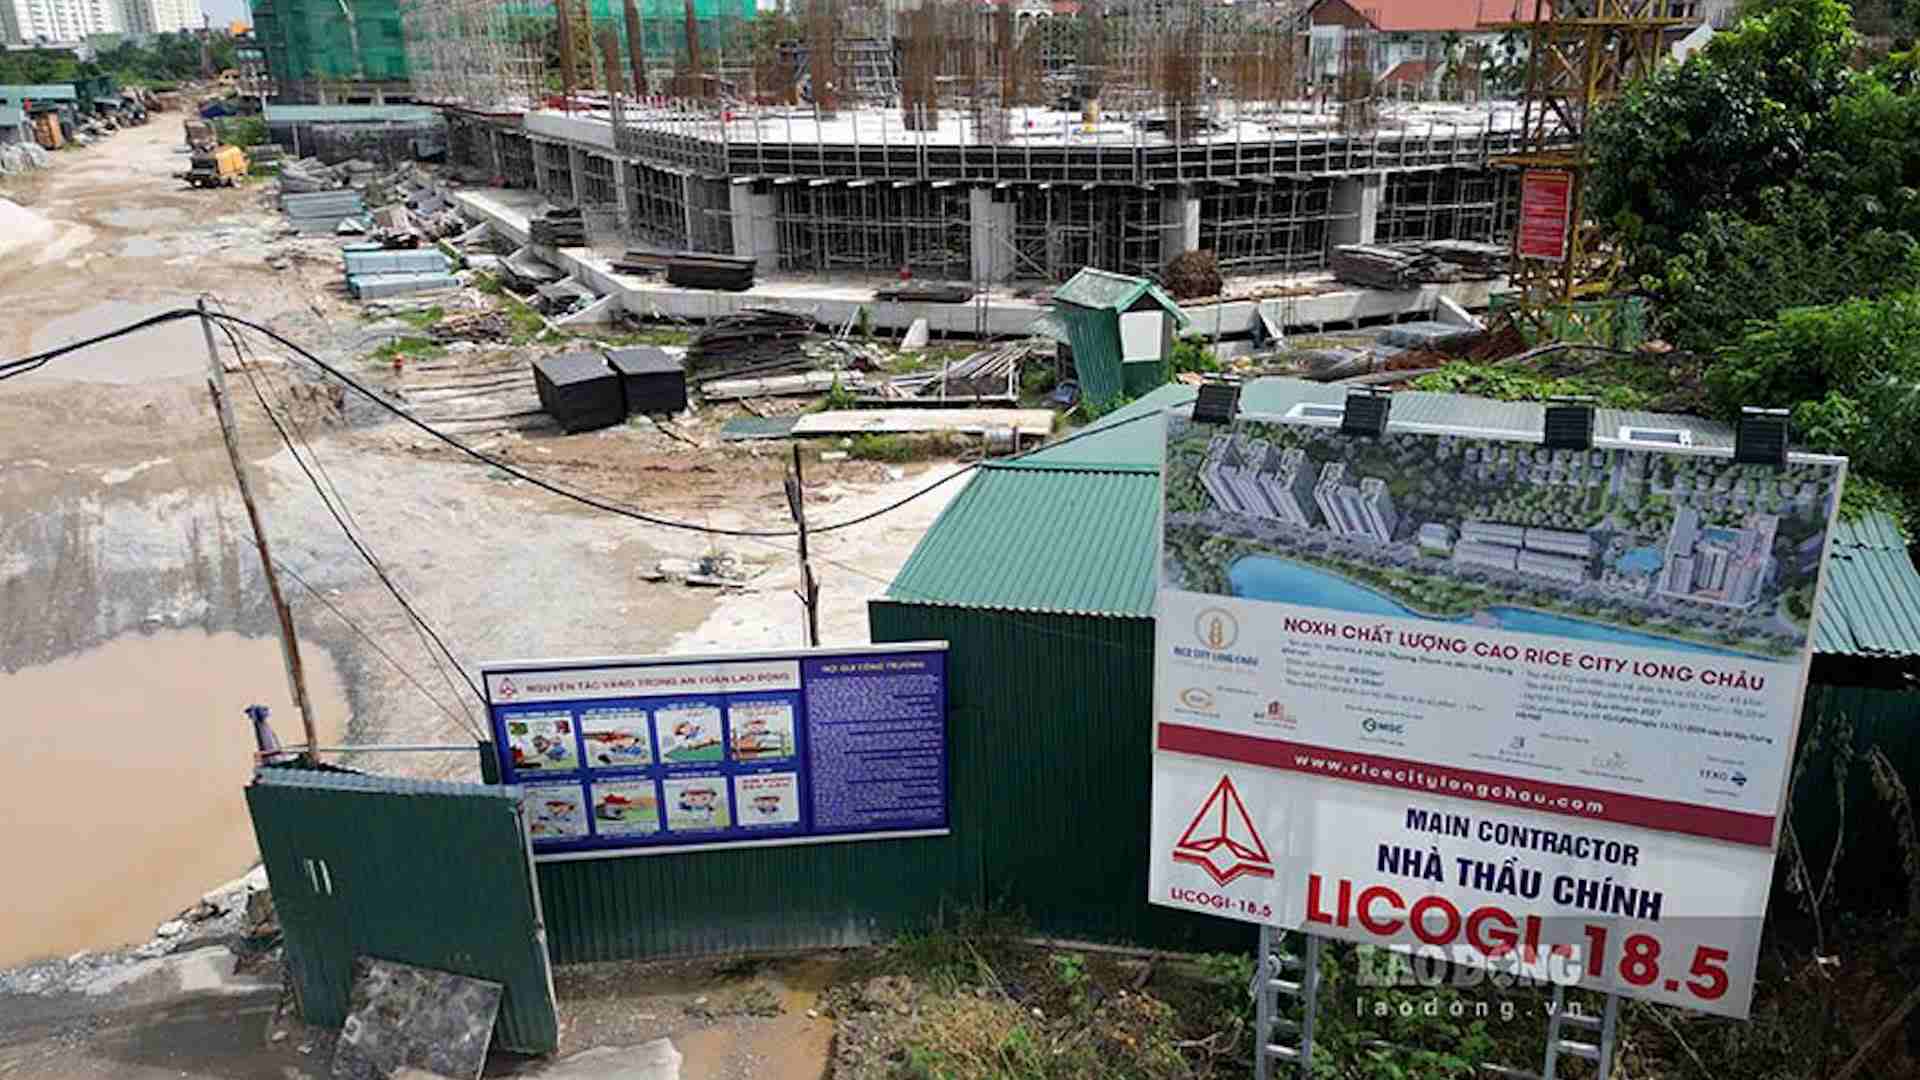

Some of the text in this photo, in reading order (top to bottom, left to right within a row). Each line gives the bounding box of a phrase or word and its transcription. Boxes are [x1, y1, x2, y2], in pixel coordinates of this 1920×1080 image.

[1283, 617, 1337, 638] NOXH
[1342, 623, 1393, 644] CHẤT
[1399, 633, 1467, 655] LƯỢNG
[1474, 641, 1519, 661] CAO
[1524, 647, 1574, 668] RICE
[1578, 653, 1629, 674] CITY
[1632, 660, 1695, 684] LONG
[1294, 754, 1604, 814] www.ricecitylongchau.com
[1405, 807, 1640, 867] MAIN CONTRACTOR
[1170, 887, 1273, 918] LICOGI-18.5
[1377, 843, 1663, 922] NHÀ THẦU CHÍNH
